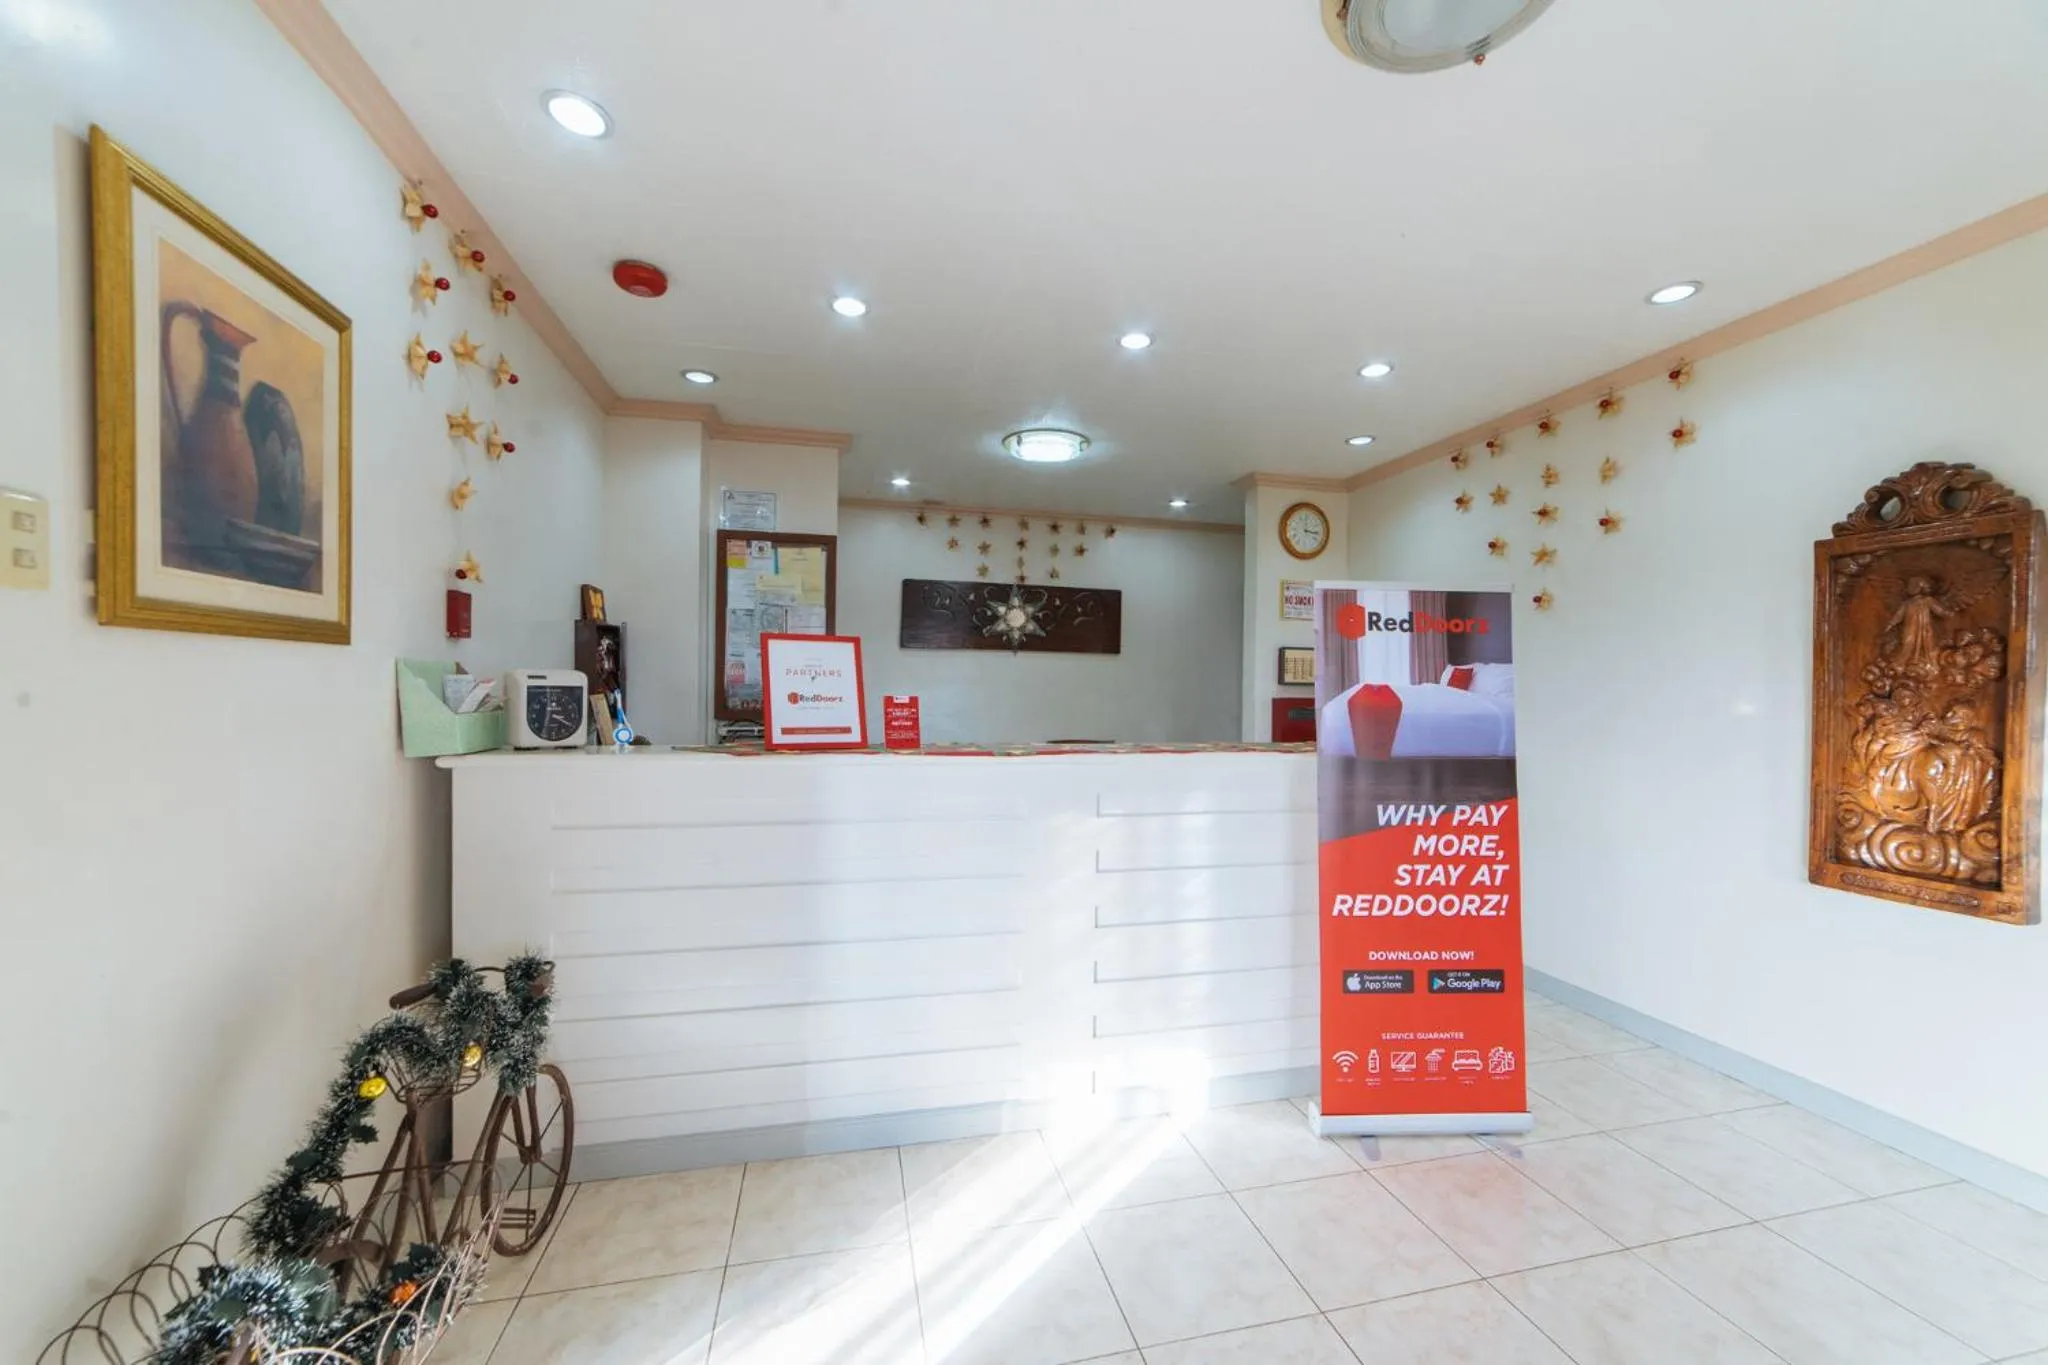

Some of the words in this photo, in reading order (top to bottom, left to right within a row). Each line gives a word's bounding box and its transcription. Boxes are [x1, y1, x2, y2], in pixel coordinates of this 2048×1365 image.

[1367, 611, 1489, 634] RedDoorz
[785, 668, 842, 677] PARTNERS
[1376, 804, 1446, 826] WHY
[1452, 804, 1508, 826] PAY
[1413, 834, 1504, 860] MORE,
[1394, 864, 1466, 886] STAY
[1470, 864, 1510, 886] AT
[1332, 894, 1509, 917] REDDOORZ!
[1368, 951, 1439, 961] DOWNLOAD
[1441, 951, 1475, 961] NOW!
[1364, 981, 1381, 990] App
[1382, 980, 1402, 989] Store
[1447, 978, 1479, 990] Google
[1480, 978, 1501, 990] Play
[1381, 1032, 1415, 1040] SERVICE
[1416, 1032, 1465, 1040] GUARANTEE
